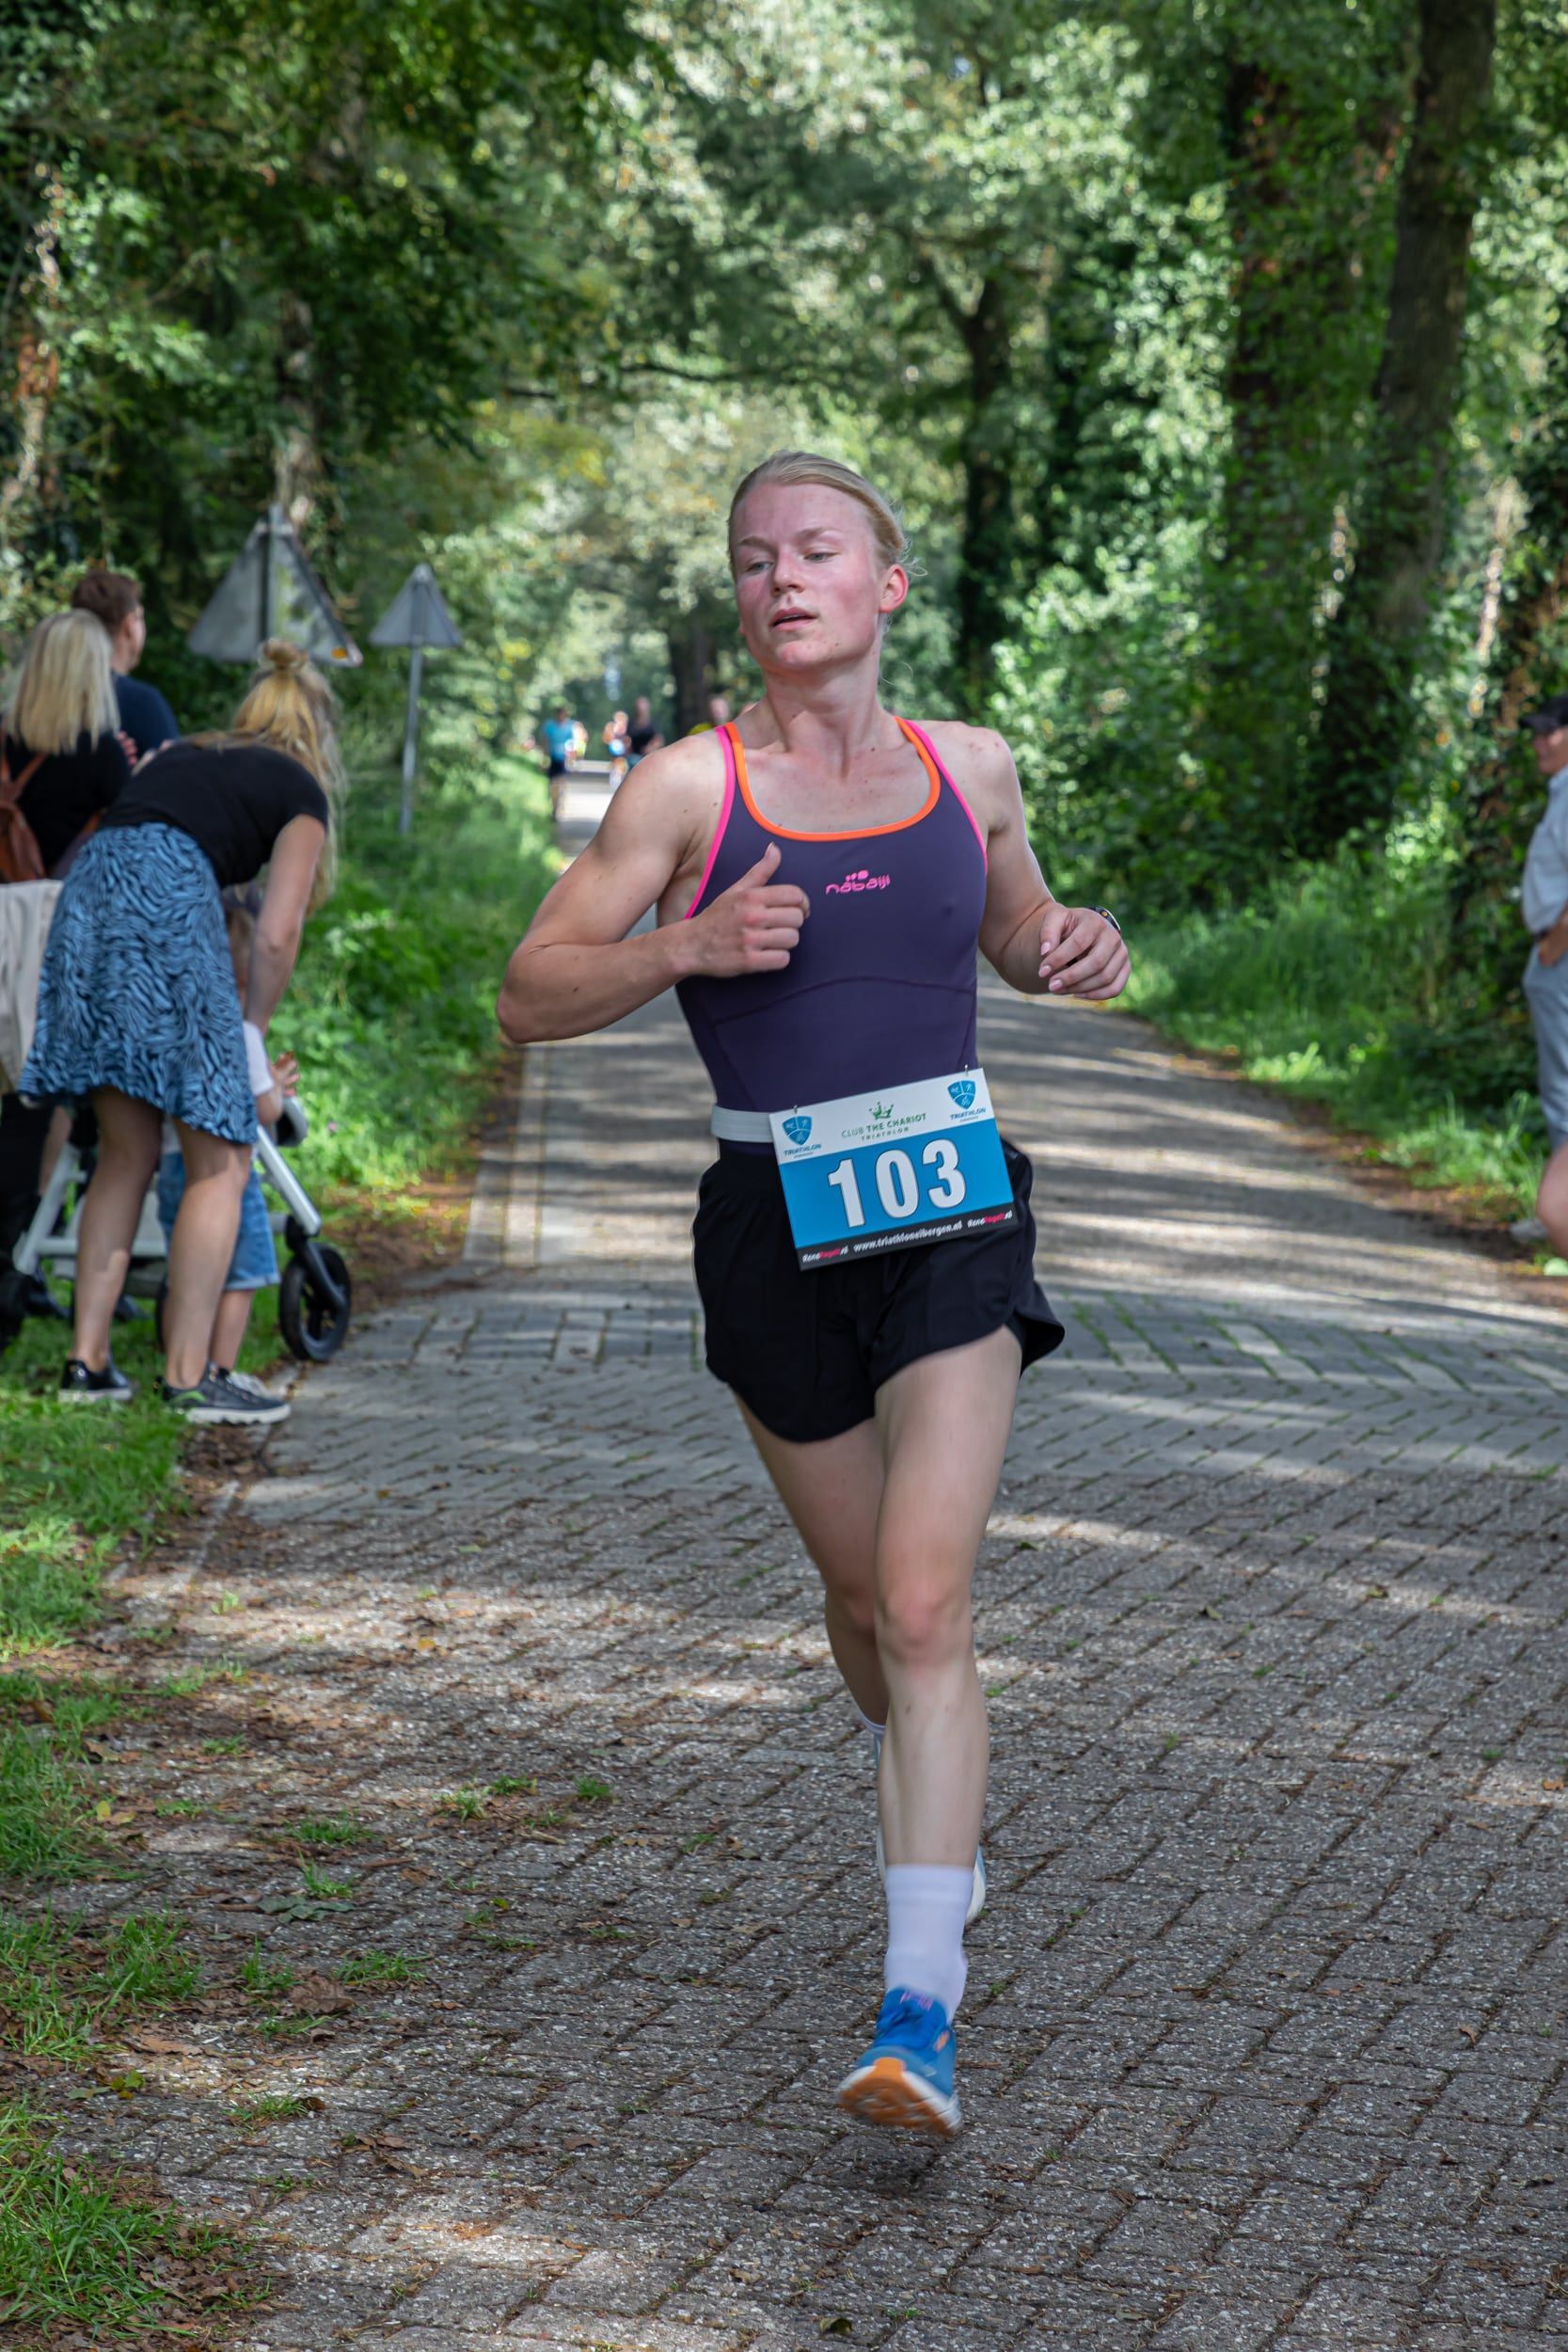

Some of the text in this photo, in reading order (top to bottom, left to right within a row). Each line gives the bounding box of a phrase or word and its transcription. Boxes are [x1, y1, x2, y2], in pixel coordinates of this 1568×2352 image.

[825, 874, 891, 895] nabaiji
[950, 1107, 987, 1120] TRIATHLON
[842, 1113, 927, 1138] CLUB THE CHARIOT
[862, 1127, 909, 1140] TRIATHLON
[784, 1144, 822, 1156] TRIATHLON
[827, 1139, 967, 1230] 103
